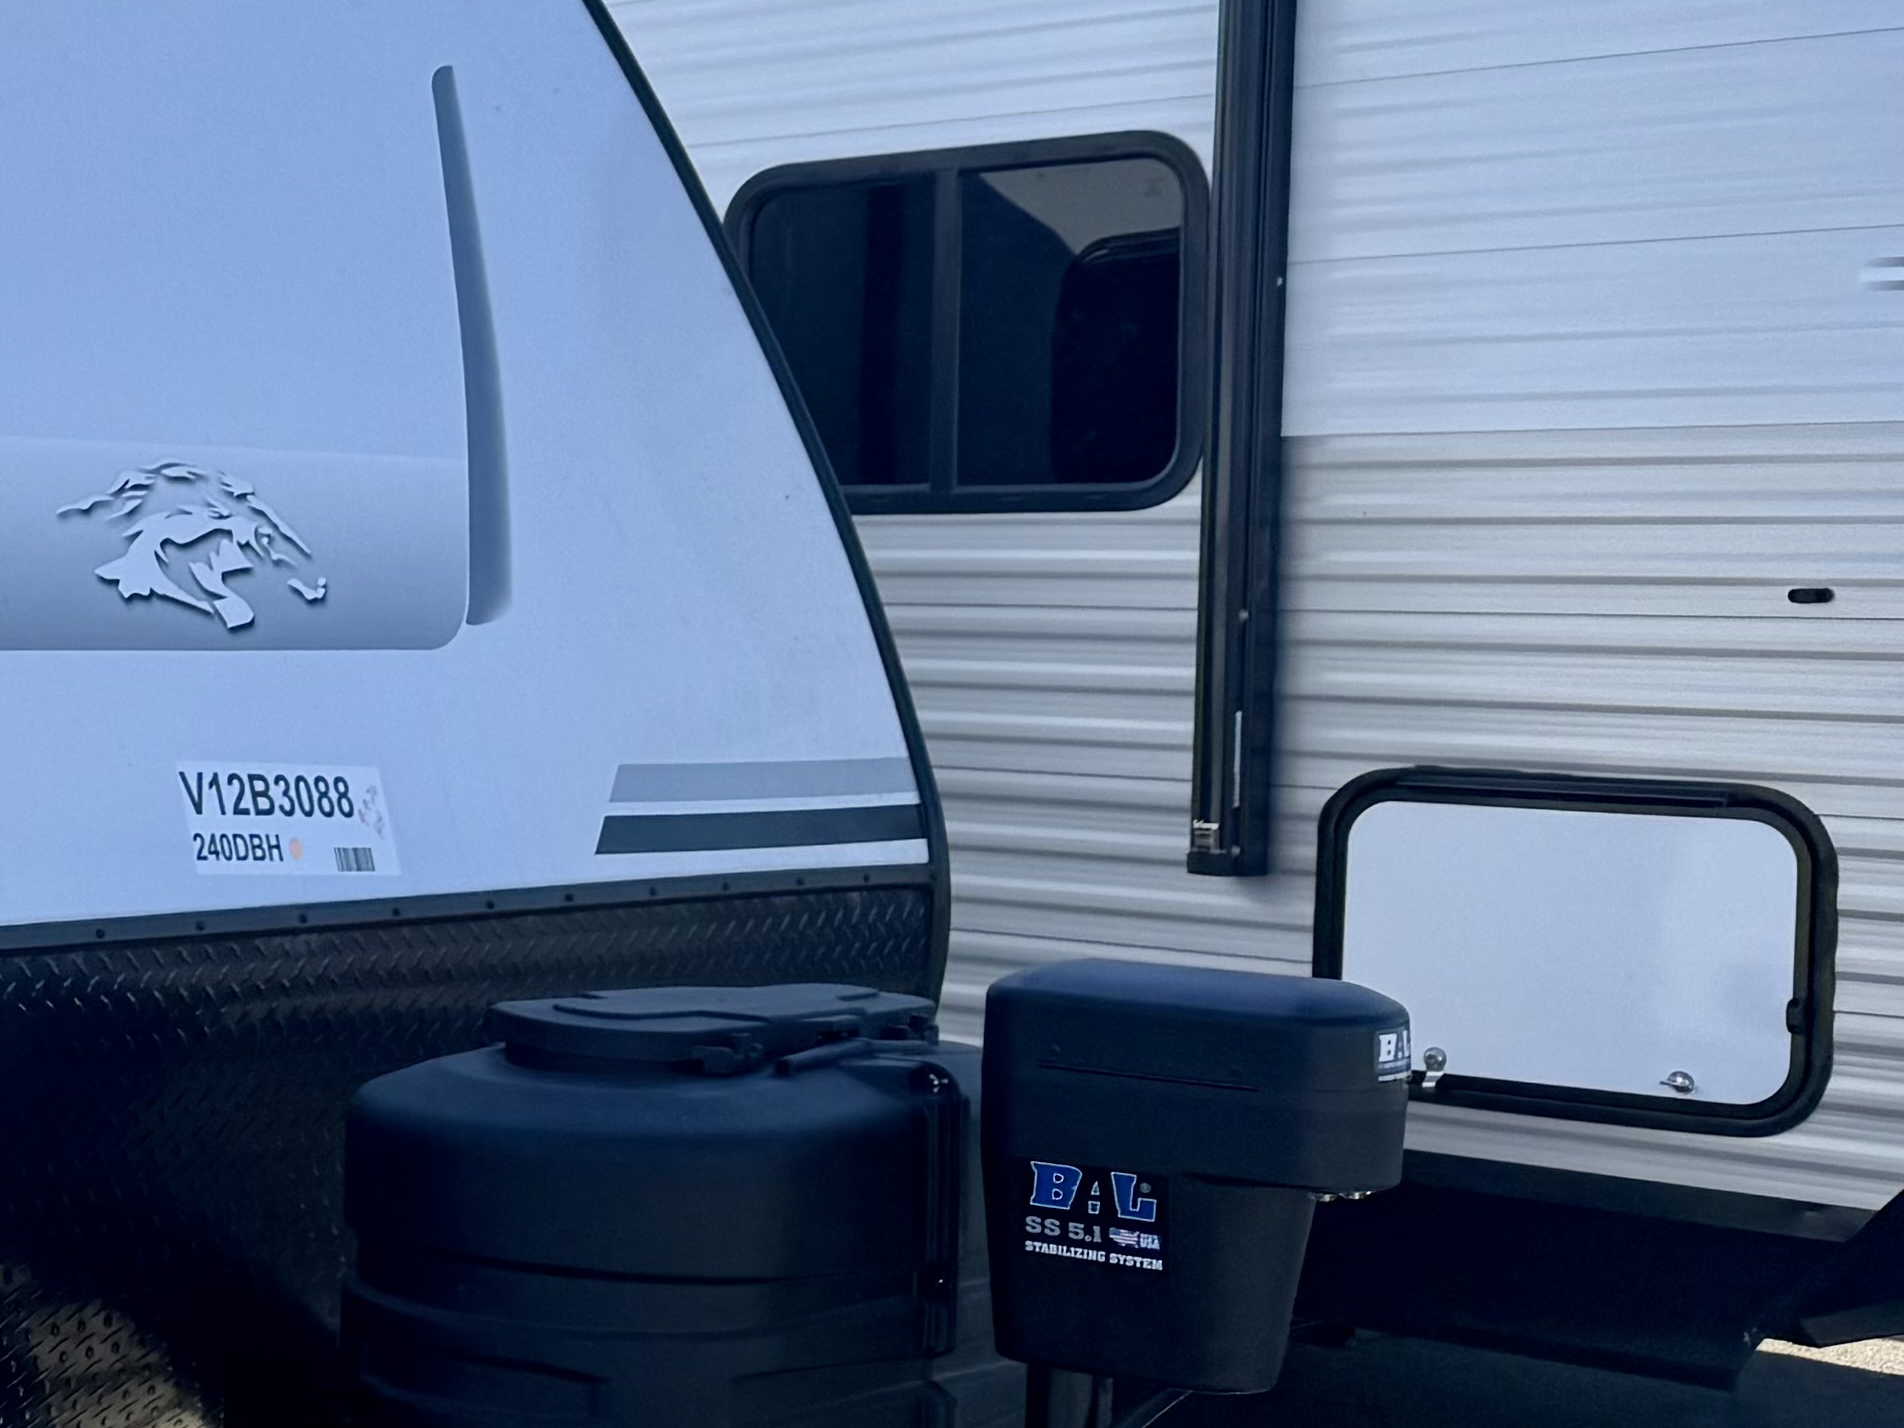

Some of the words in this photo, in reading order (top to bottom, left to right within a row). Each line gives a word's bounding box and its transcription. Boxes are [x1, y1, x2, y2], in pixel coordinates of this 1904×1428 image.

[178, 770, 355, 819] V12B3088
[192, 832, 284, 863] 240DBH
[1029, 1160, 1158, 1223] BAL
[1025, 1215, 1061, 1237] SS
[1067, 1222, 1103, 1243] 5.1
[1024, 1240, 1106, 1263] STABILIZING
[1109, 1252, 1164, 1271] SYSTEM
